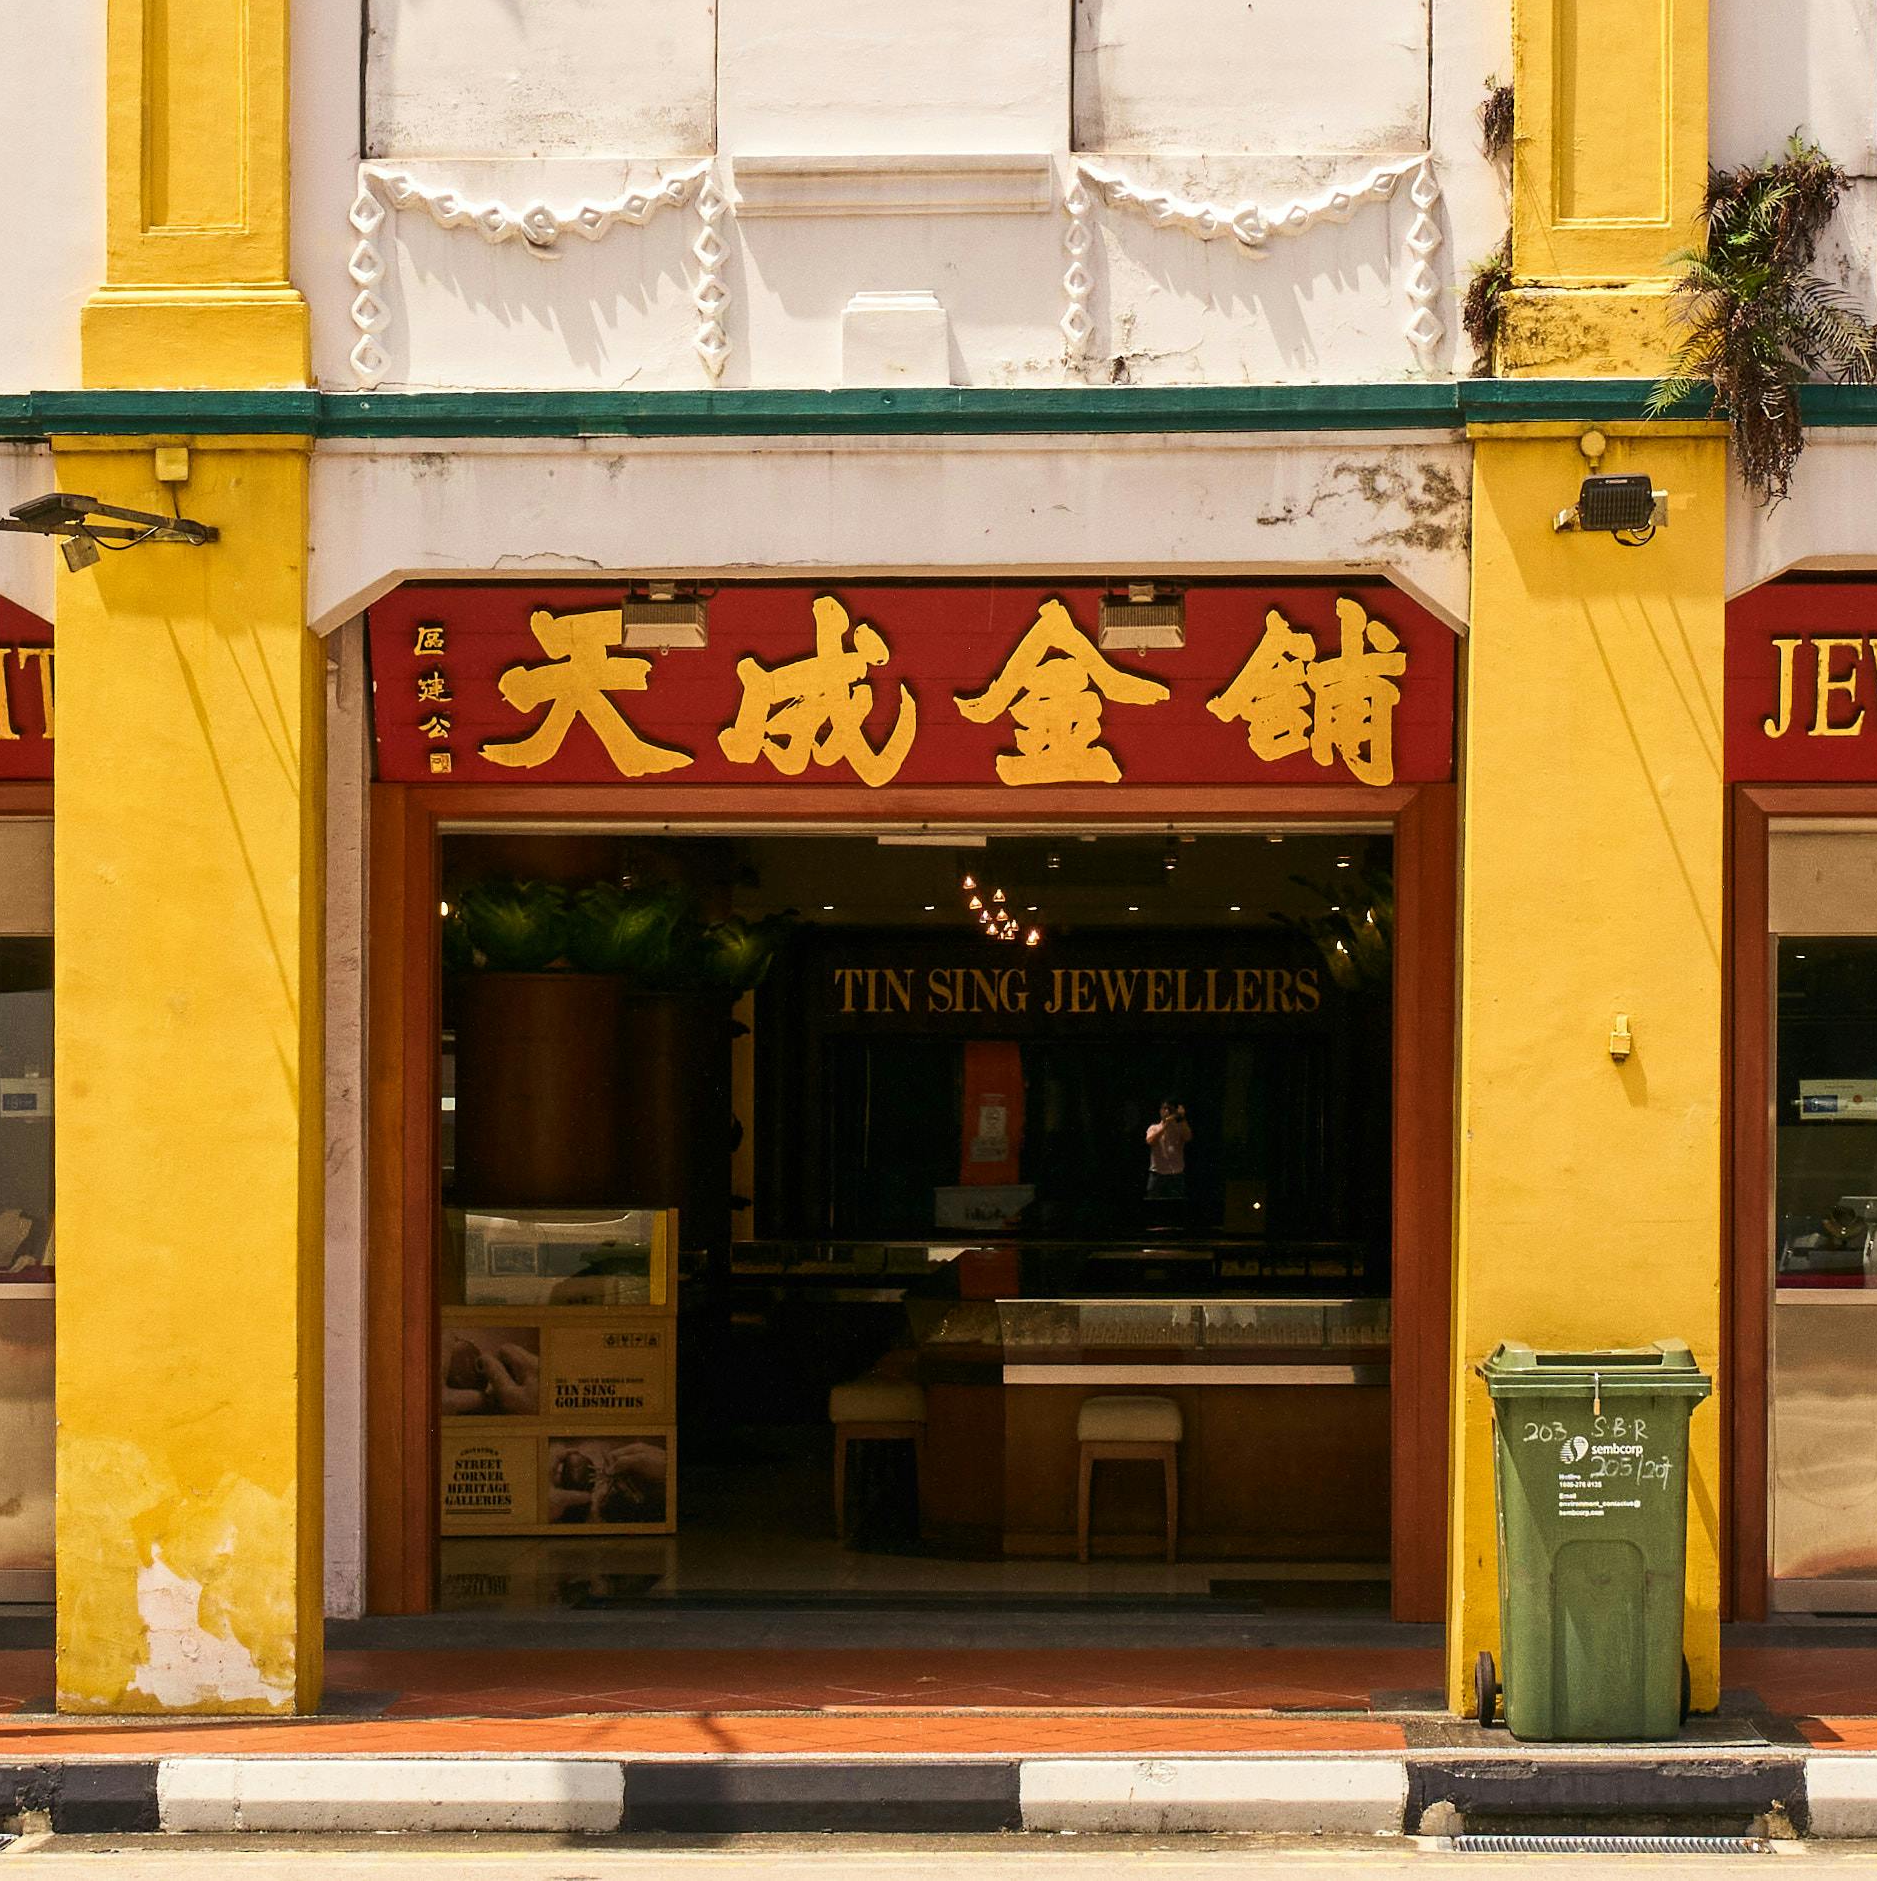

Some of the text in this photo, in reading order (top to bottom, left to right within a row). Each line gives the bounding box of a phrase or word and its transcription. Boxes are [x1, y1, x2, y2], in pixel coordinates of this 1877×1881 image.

[479, 595, 1408, 787] 天成金舖
[834, 967, 1320, 1016] TIN SING JEWELLERS
[555, 1385, 616, 1395] TIN SING
[555, 1397, 644, 1408] GOLDSMITHS
[1522, 1421, 1567, 1443] 203
[1591, 1443, 1644, 1456] sembcorp
[455, 1459, 503, 1469] STREET
[453, 1471, 504, 1481] CORNER
[447, 1483, 510, 1494] HERITAGE
[445, 1495, 512, 1505] GALLERIES
